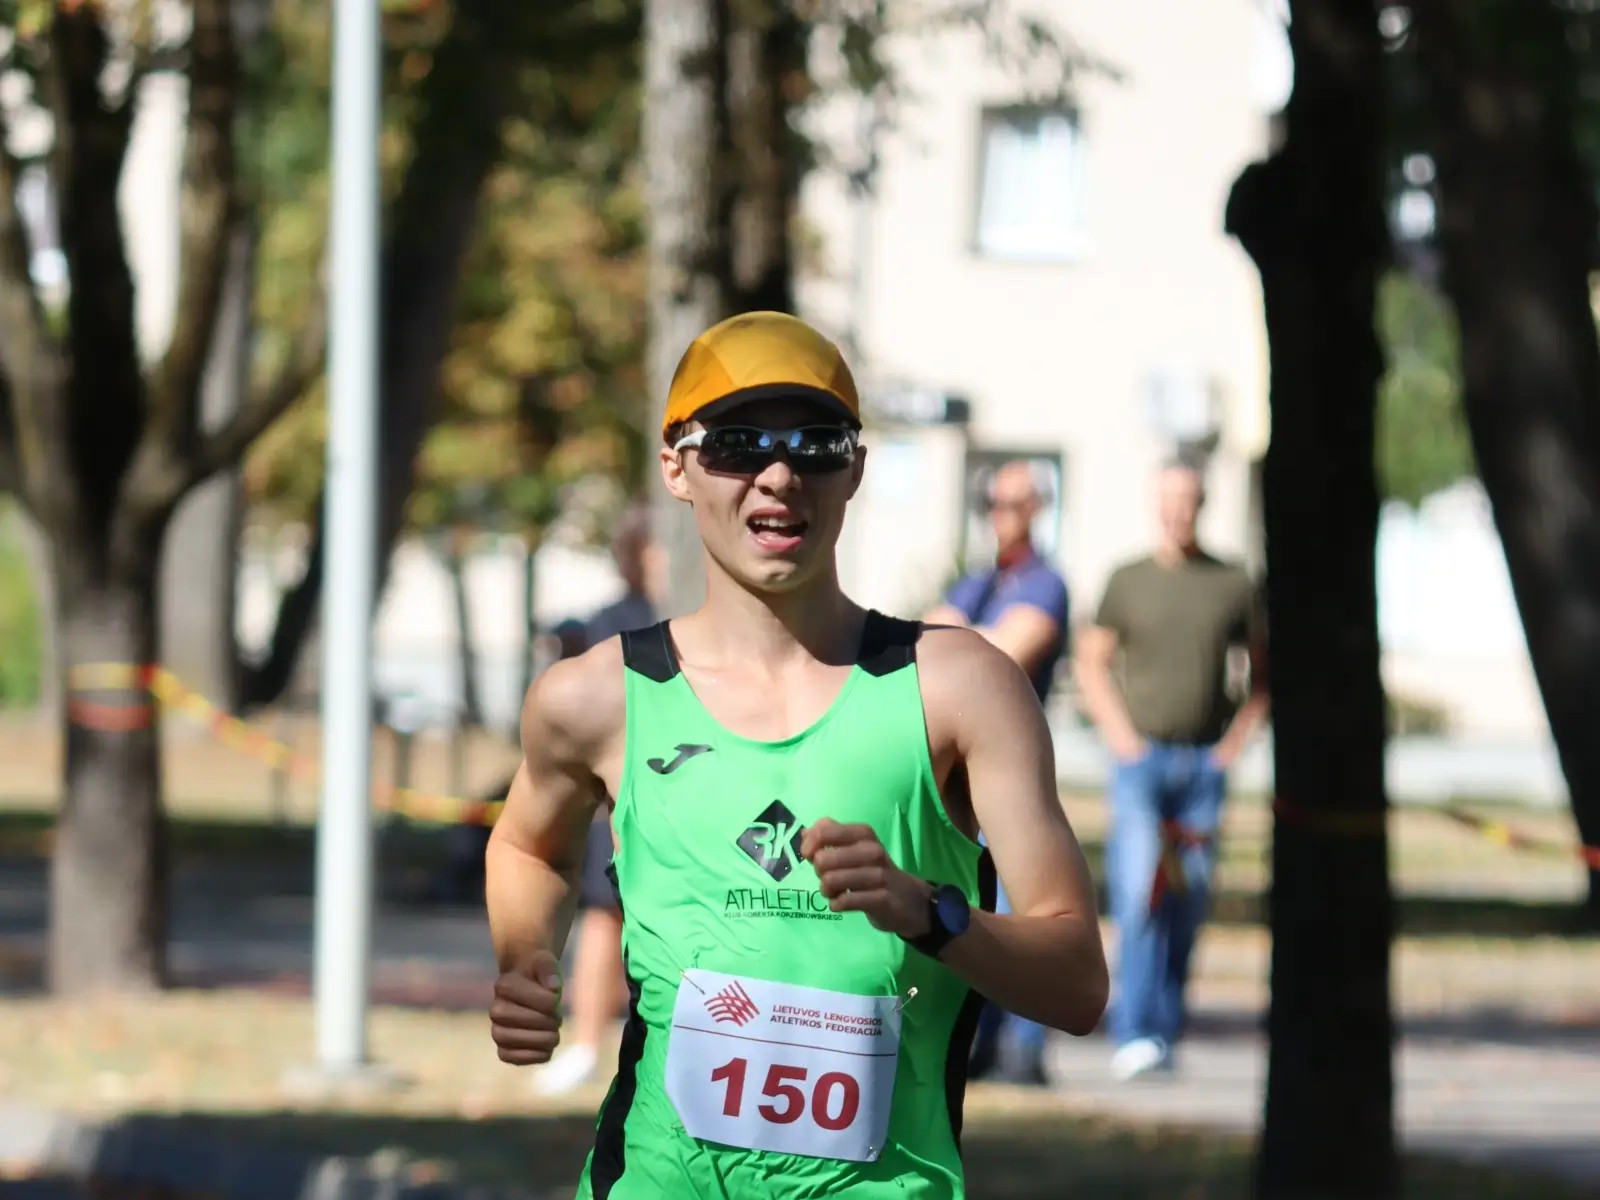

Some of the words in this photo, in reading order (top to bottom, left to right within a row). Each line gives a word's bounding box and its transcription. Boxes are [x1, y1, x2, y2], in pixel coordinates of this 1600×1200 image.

[725, 888, 828, 912] ATHLETIC
[770, 1015, 822, 1029] ATLETIKOS
[826, 1022, 882, 1036] FEDERACIJA
[773, 1005, 820, 1018] LIETUVOS
[824, 1012, 882, 1026] LENGVOSIOS
[711, 1057, 860, 1130] 150
